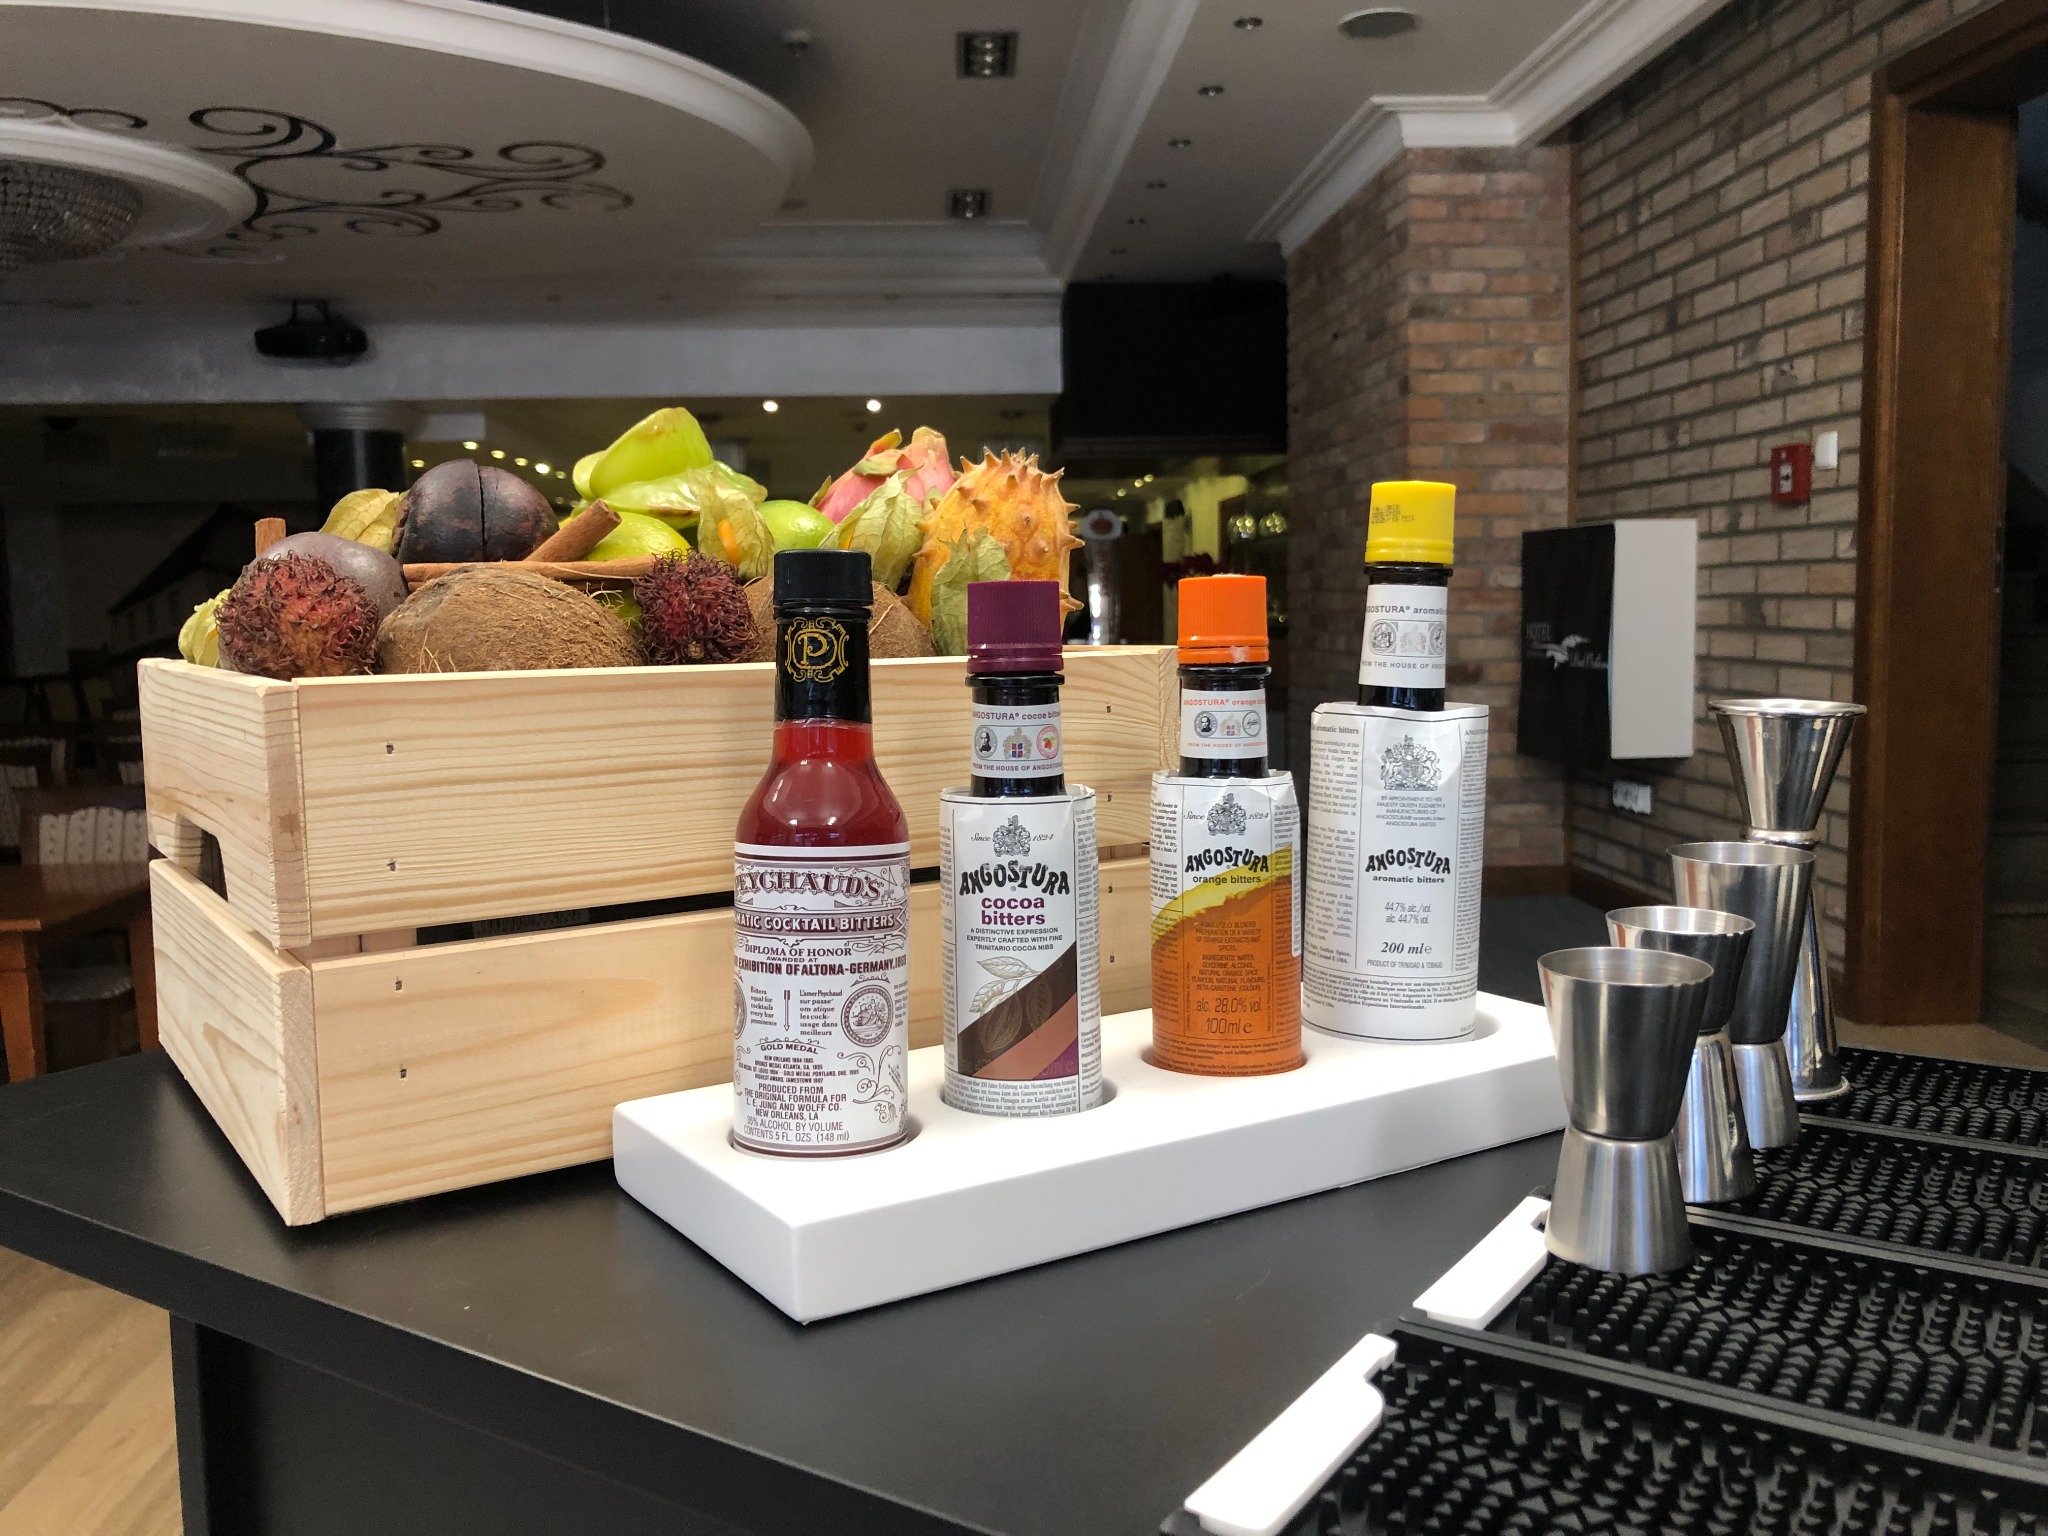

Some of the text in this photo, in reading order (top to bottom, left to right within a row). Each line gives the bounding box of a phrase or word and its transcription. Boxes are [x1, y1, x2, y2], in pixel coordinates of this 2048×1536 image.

[1338, 726, 1360, 734] bitters
[1184, 810, 1270, 820] Since 1824
[970, 832, 1054, 842] Since 1824
[1184, 846, 1270, 873] ANGOSTURA
[1365, 847, 1451, 874] ANGOSTURA
[959, 860, 1070, 896] ANGOSTURA
[1192, 875, 1261, 885] orange bitters
[1373, 875, 1444, 884] aromatic bitters
[981, 897, 1046, 926] cocoa bitters
[764, 916, 839, 932] COCKTAIL
[840, 913, 896, 932] BITTERS
[1016, 927, 1058, 935] EXPRESSION
[966, 935, 996, 943] EXPERTLY
[745, 944, 852, 957] DIPLOMA OF HONOR
[1381, 942, 1405, 954] 200
[739, 957, 782, 975] EXHIBITION
[786, 964, 800, 976] OF
[1390, 960, 1396, 968] OF
[818, 988, 842, 997] Peychaud
[1214, 997, 1247, 1013] 28.0%
[786, 1044, 818, 1054] MEDAL
[758, 1083, 824, 1094] PRODUCED FROM
[744, 1088, 846, 1103] THE ORIGINAL FORMULA FOR
[747, 1097, 842, 1111] L. E. JUNG AND WOLFF CO.
[755, 1108, 818, 1121] NEW ORLEANS, LA
[747, 1116, 844, 1131] 35% ALCOHOL BY VOLUME
[744, 1125, 850, 1143] CONTENTS 5 FL. OZS. (148 ml)
